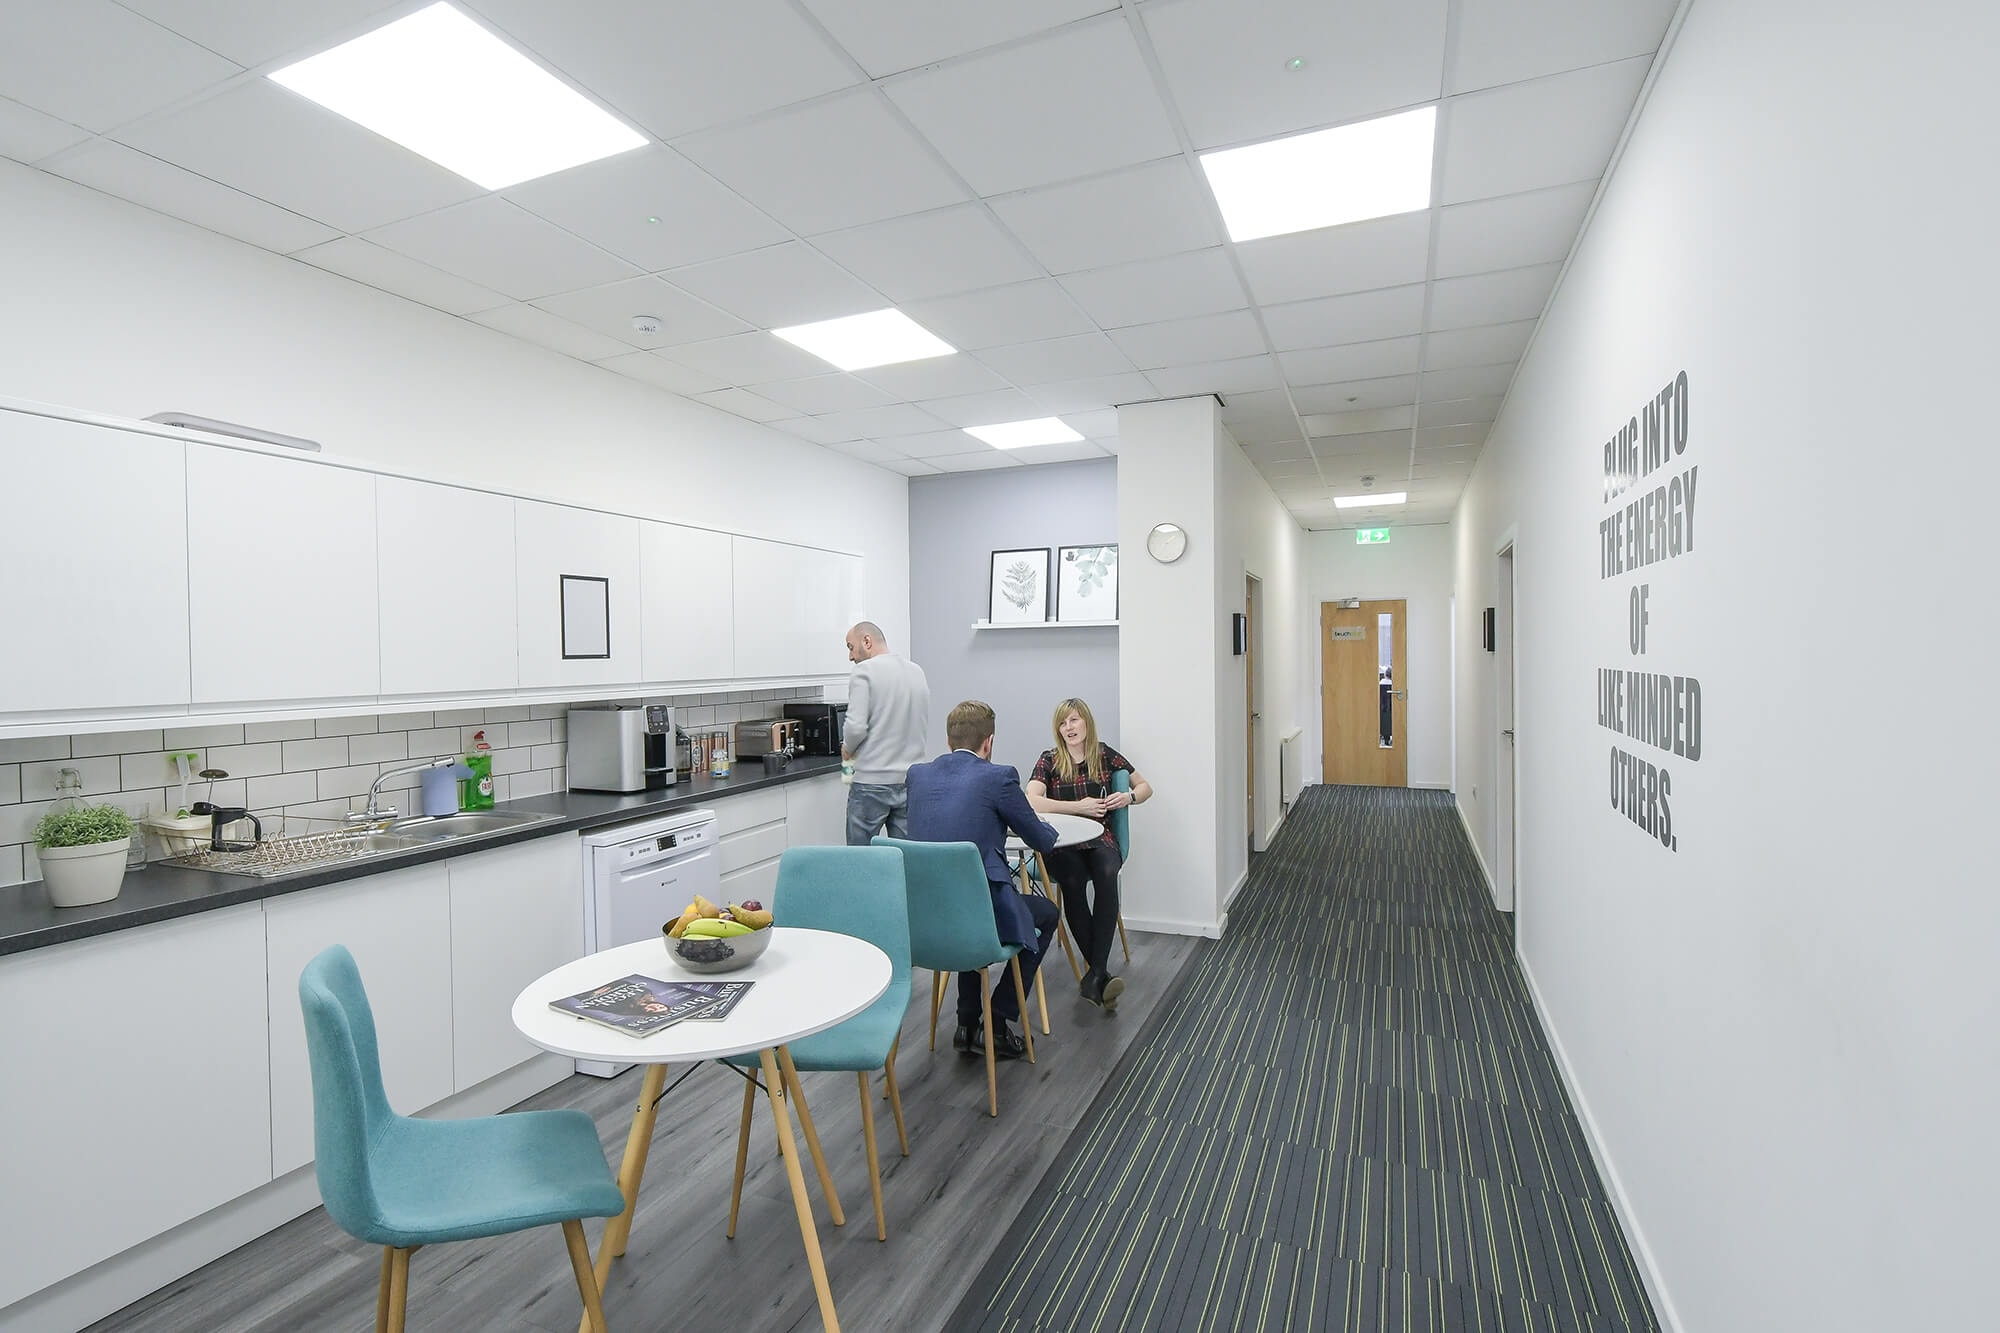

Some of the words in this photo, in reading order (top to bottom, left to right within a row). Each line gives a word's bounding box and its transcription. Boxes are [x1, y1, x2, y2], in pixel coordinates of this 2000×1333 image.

[1604, 415, 1638, 504] PLUG
[1642, 370, 1689, 477] INTO
[1600, 509, 1623, 580] THE
[1626, 465, 1698, 572] ENERGY
[1630, 584, 1649, 656] OF
[1598, 668, 1624, 734] LIKE
[1626, 671, 1702, 762] MINDED
[1610, 745, 1678, 853] OTHERS.
